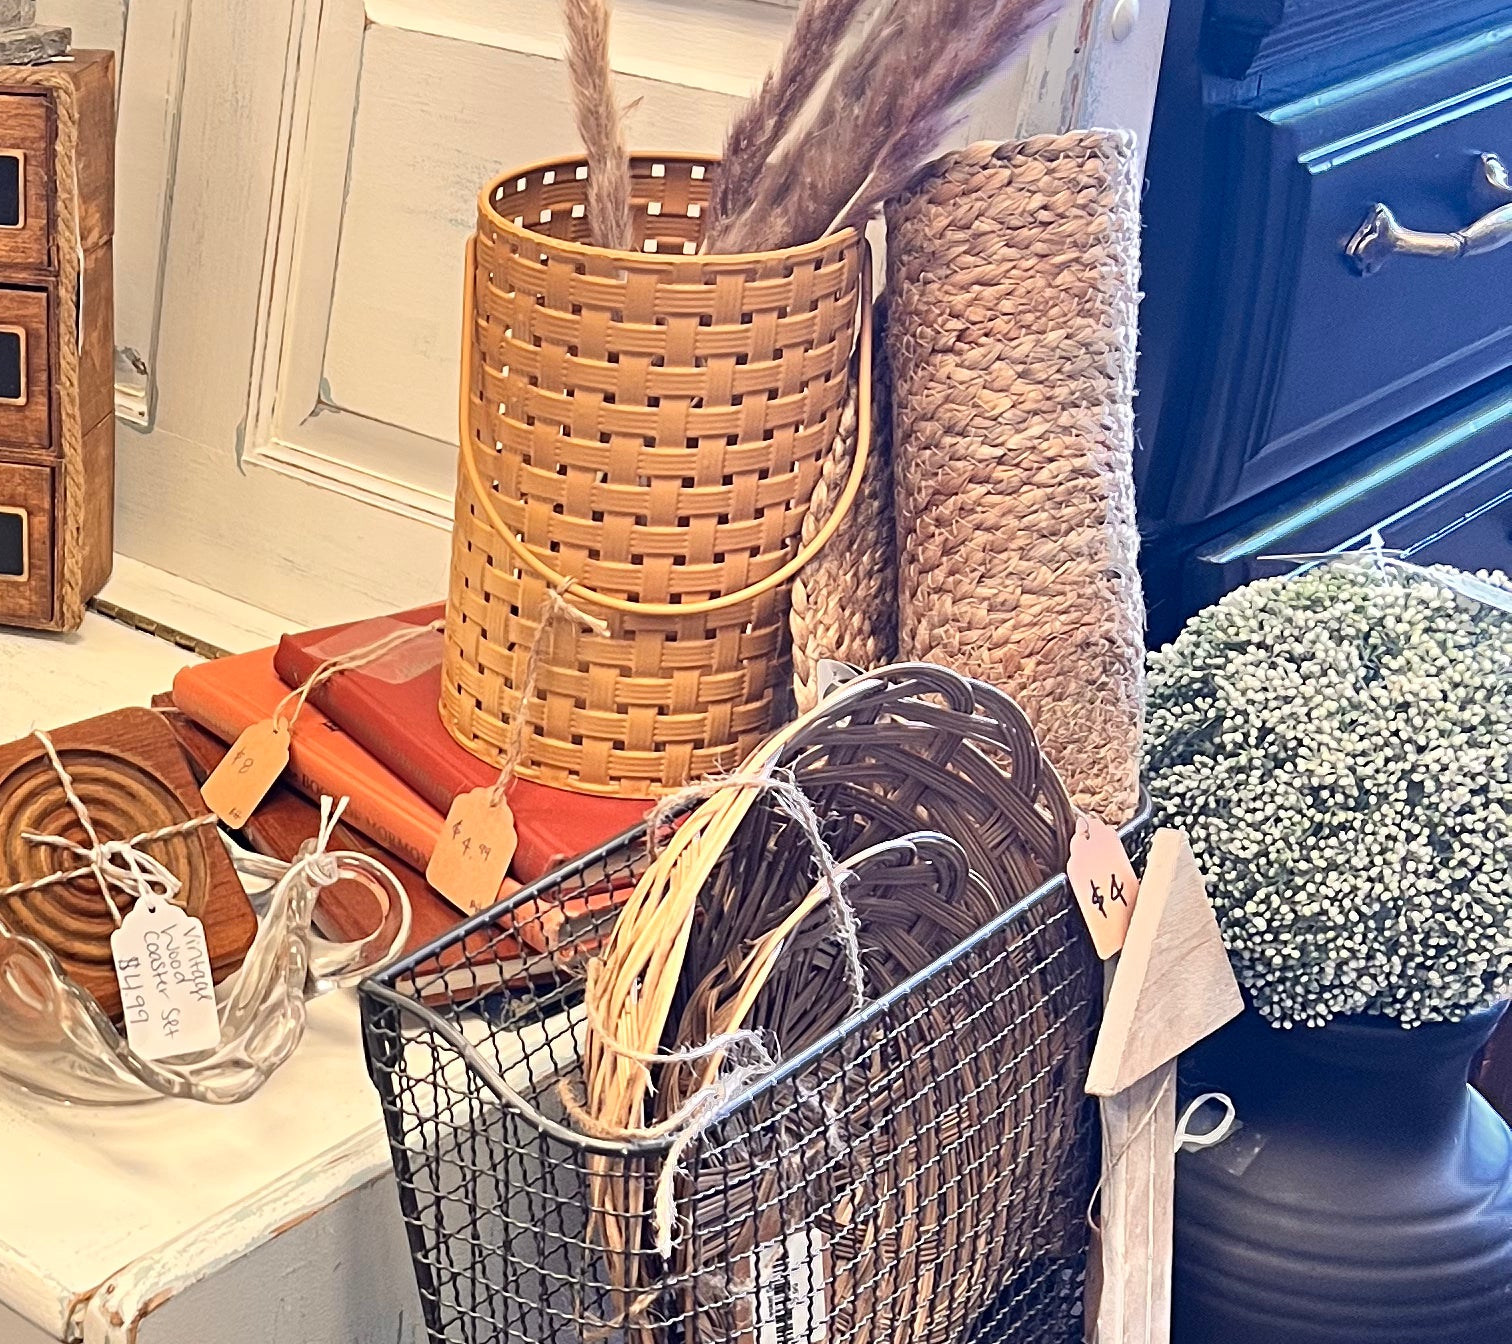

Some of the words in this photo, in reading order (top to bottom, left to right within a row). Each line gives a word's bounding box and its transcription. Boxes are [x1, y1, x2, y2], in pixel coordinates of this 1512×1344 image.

[1090, 873, 1128, 919] $4
[143, 930, 170, 1000] Coaster
[160, 1007, 181, 1040] Set
[160, 923, 194, 985] Wood
[183, 925, 213, 1002] Vintage
[118, 956, 150, 1024] $4.99
